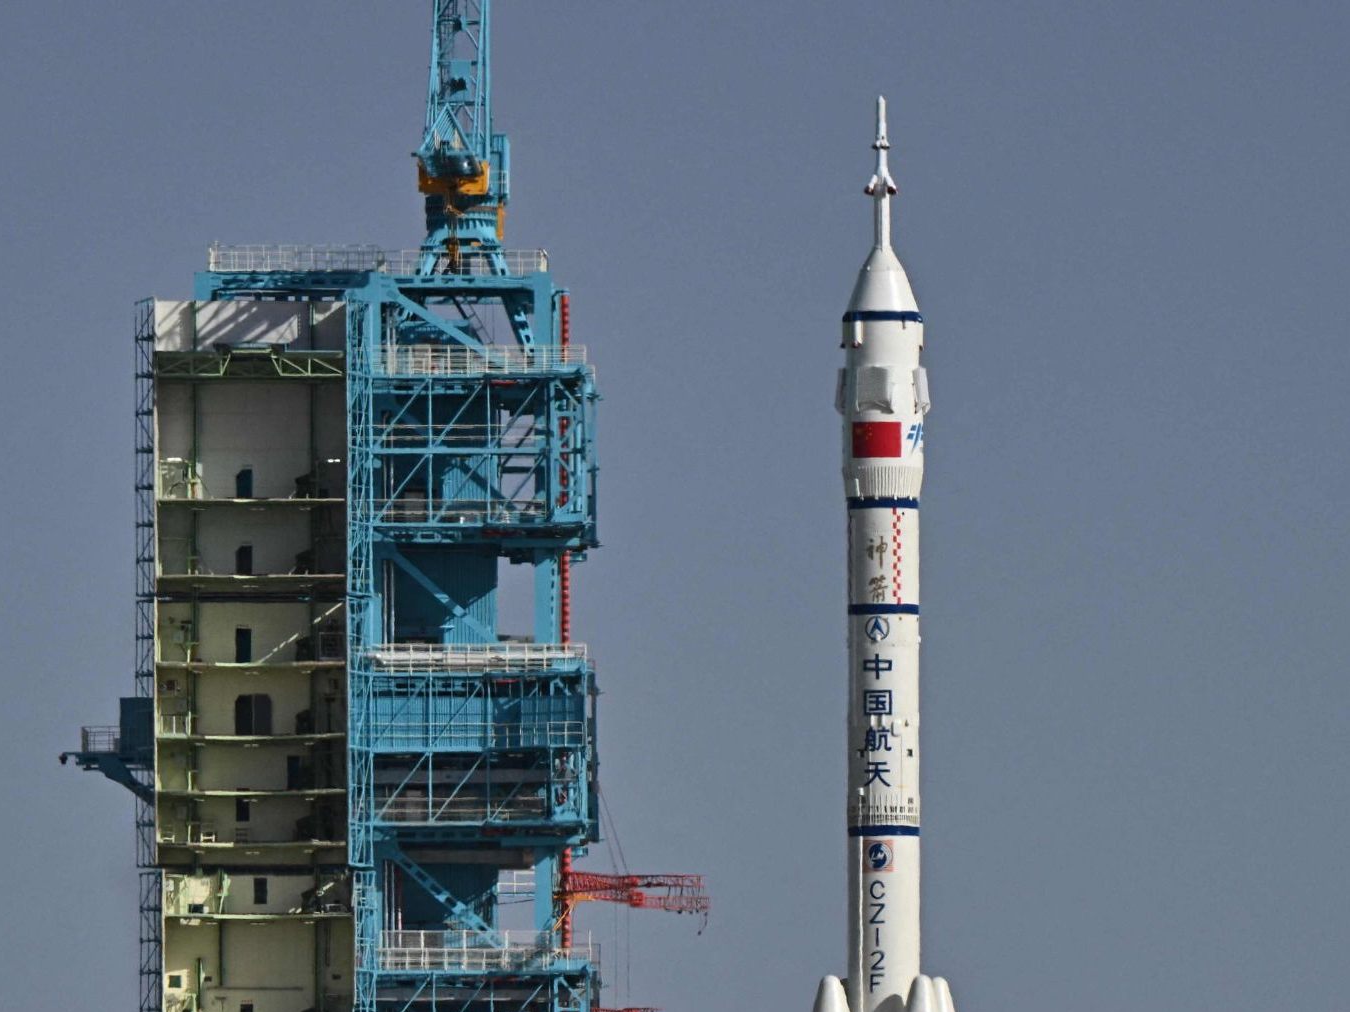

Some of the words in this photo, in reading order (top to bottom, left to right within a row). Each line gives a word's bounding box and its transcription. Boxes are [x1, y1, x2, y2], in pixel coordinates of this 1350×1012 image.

[867, 536, 888, 602] 神箭
[863, 653, 892, 788] 中国航天
